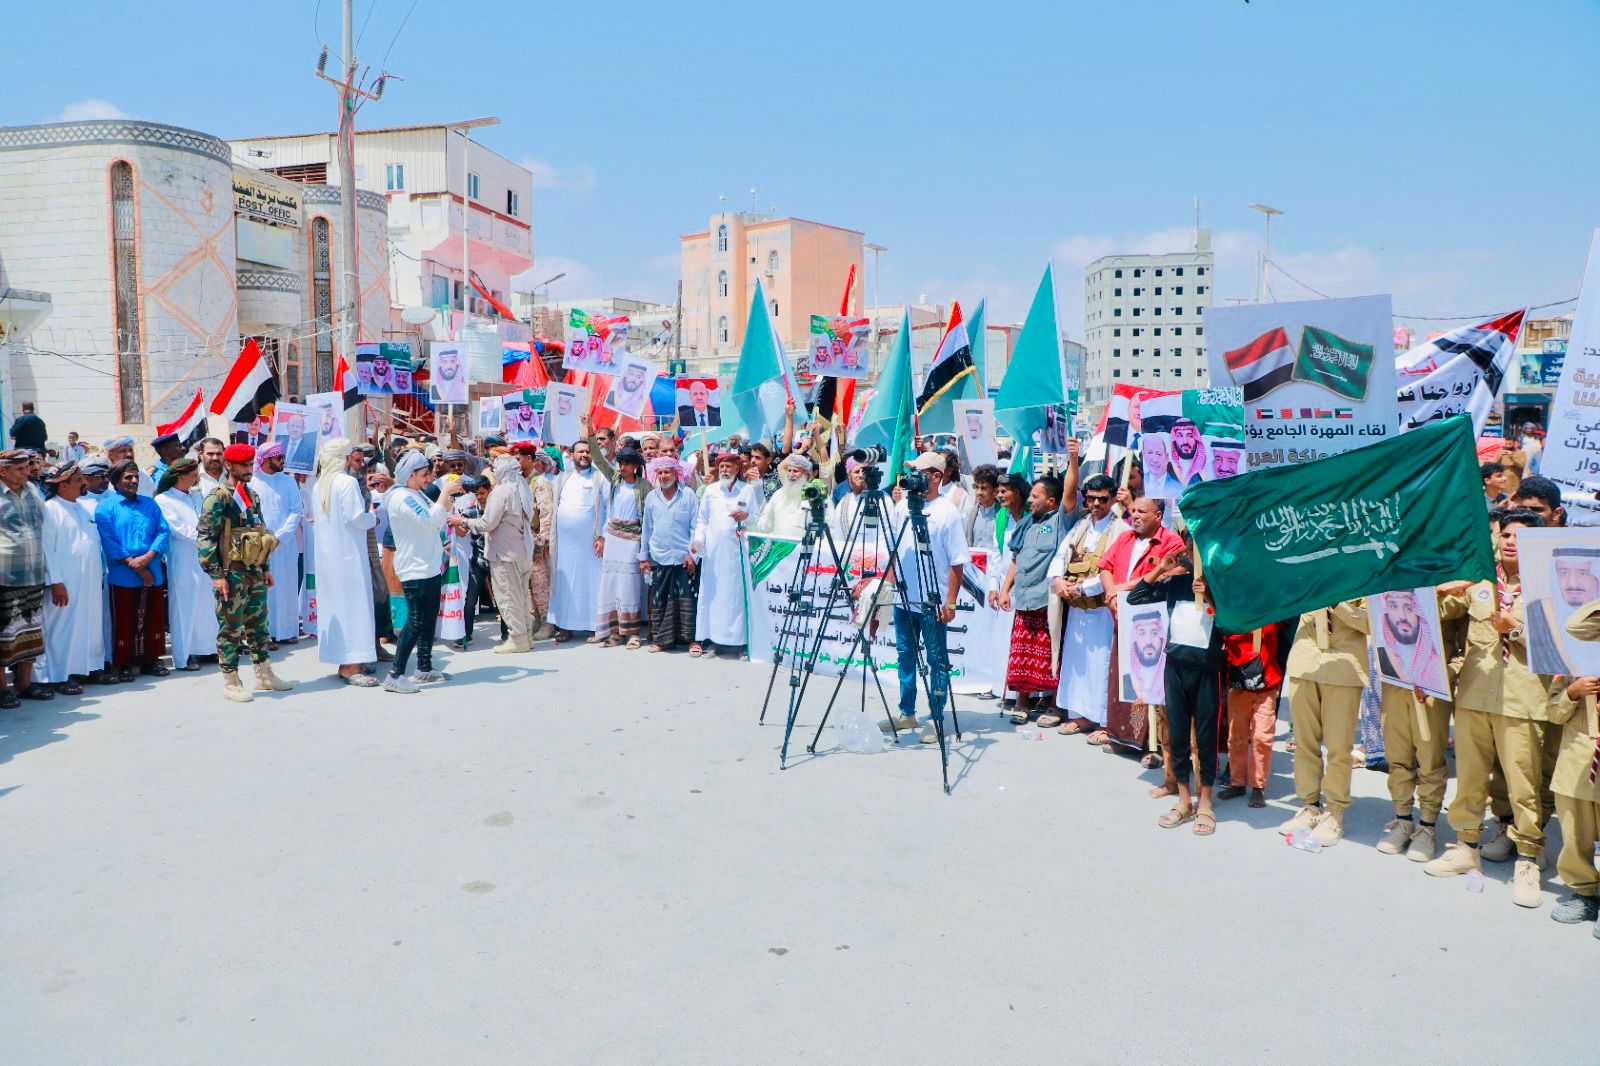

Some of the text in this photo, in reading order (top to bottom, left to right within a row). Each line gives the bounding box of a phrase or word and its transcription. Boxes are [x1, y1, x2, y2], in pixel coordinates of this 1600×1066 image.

[238, 197, 264, 211] POST
[1266, 424, 1307, 440] الجامع
[1310, 424, 1354, 439] المهرة
[1358, 424, 1386, 437] لقاء
